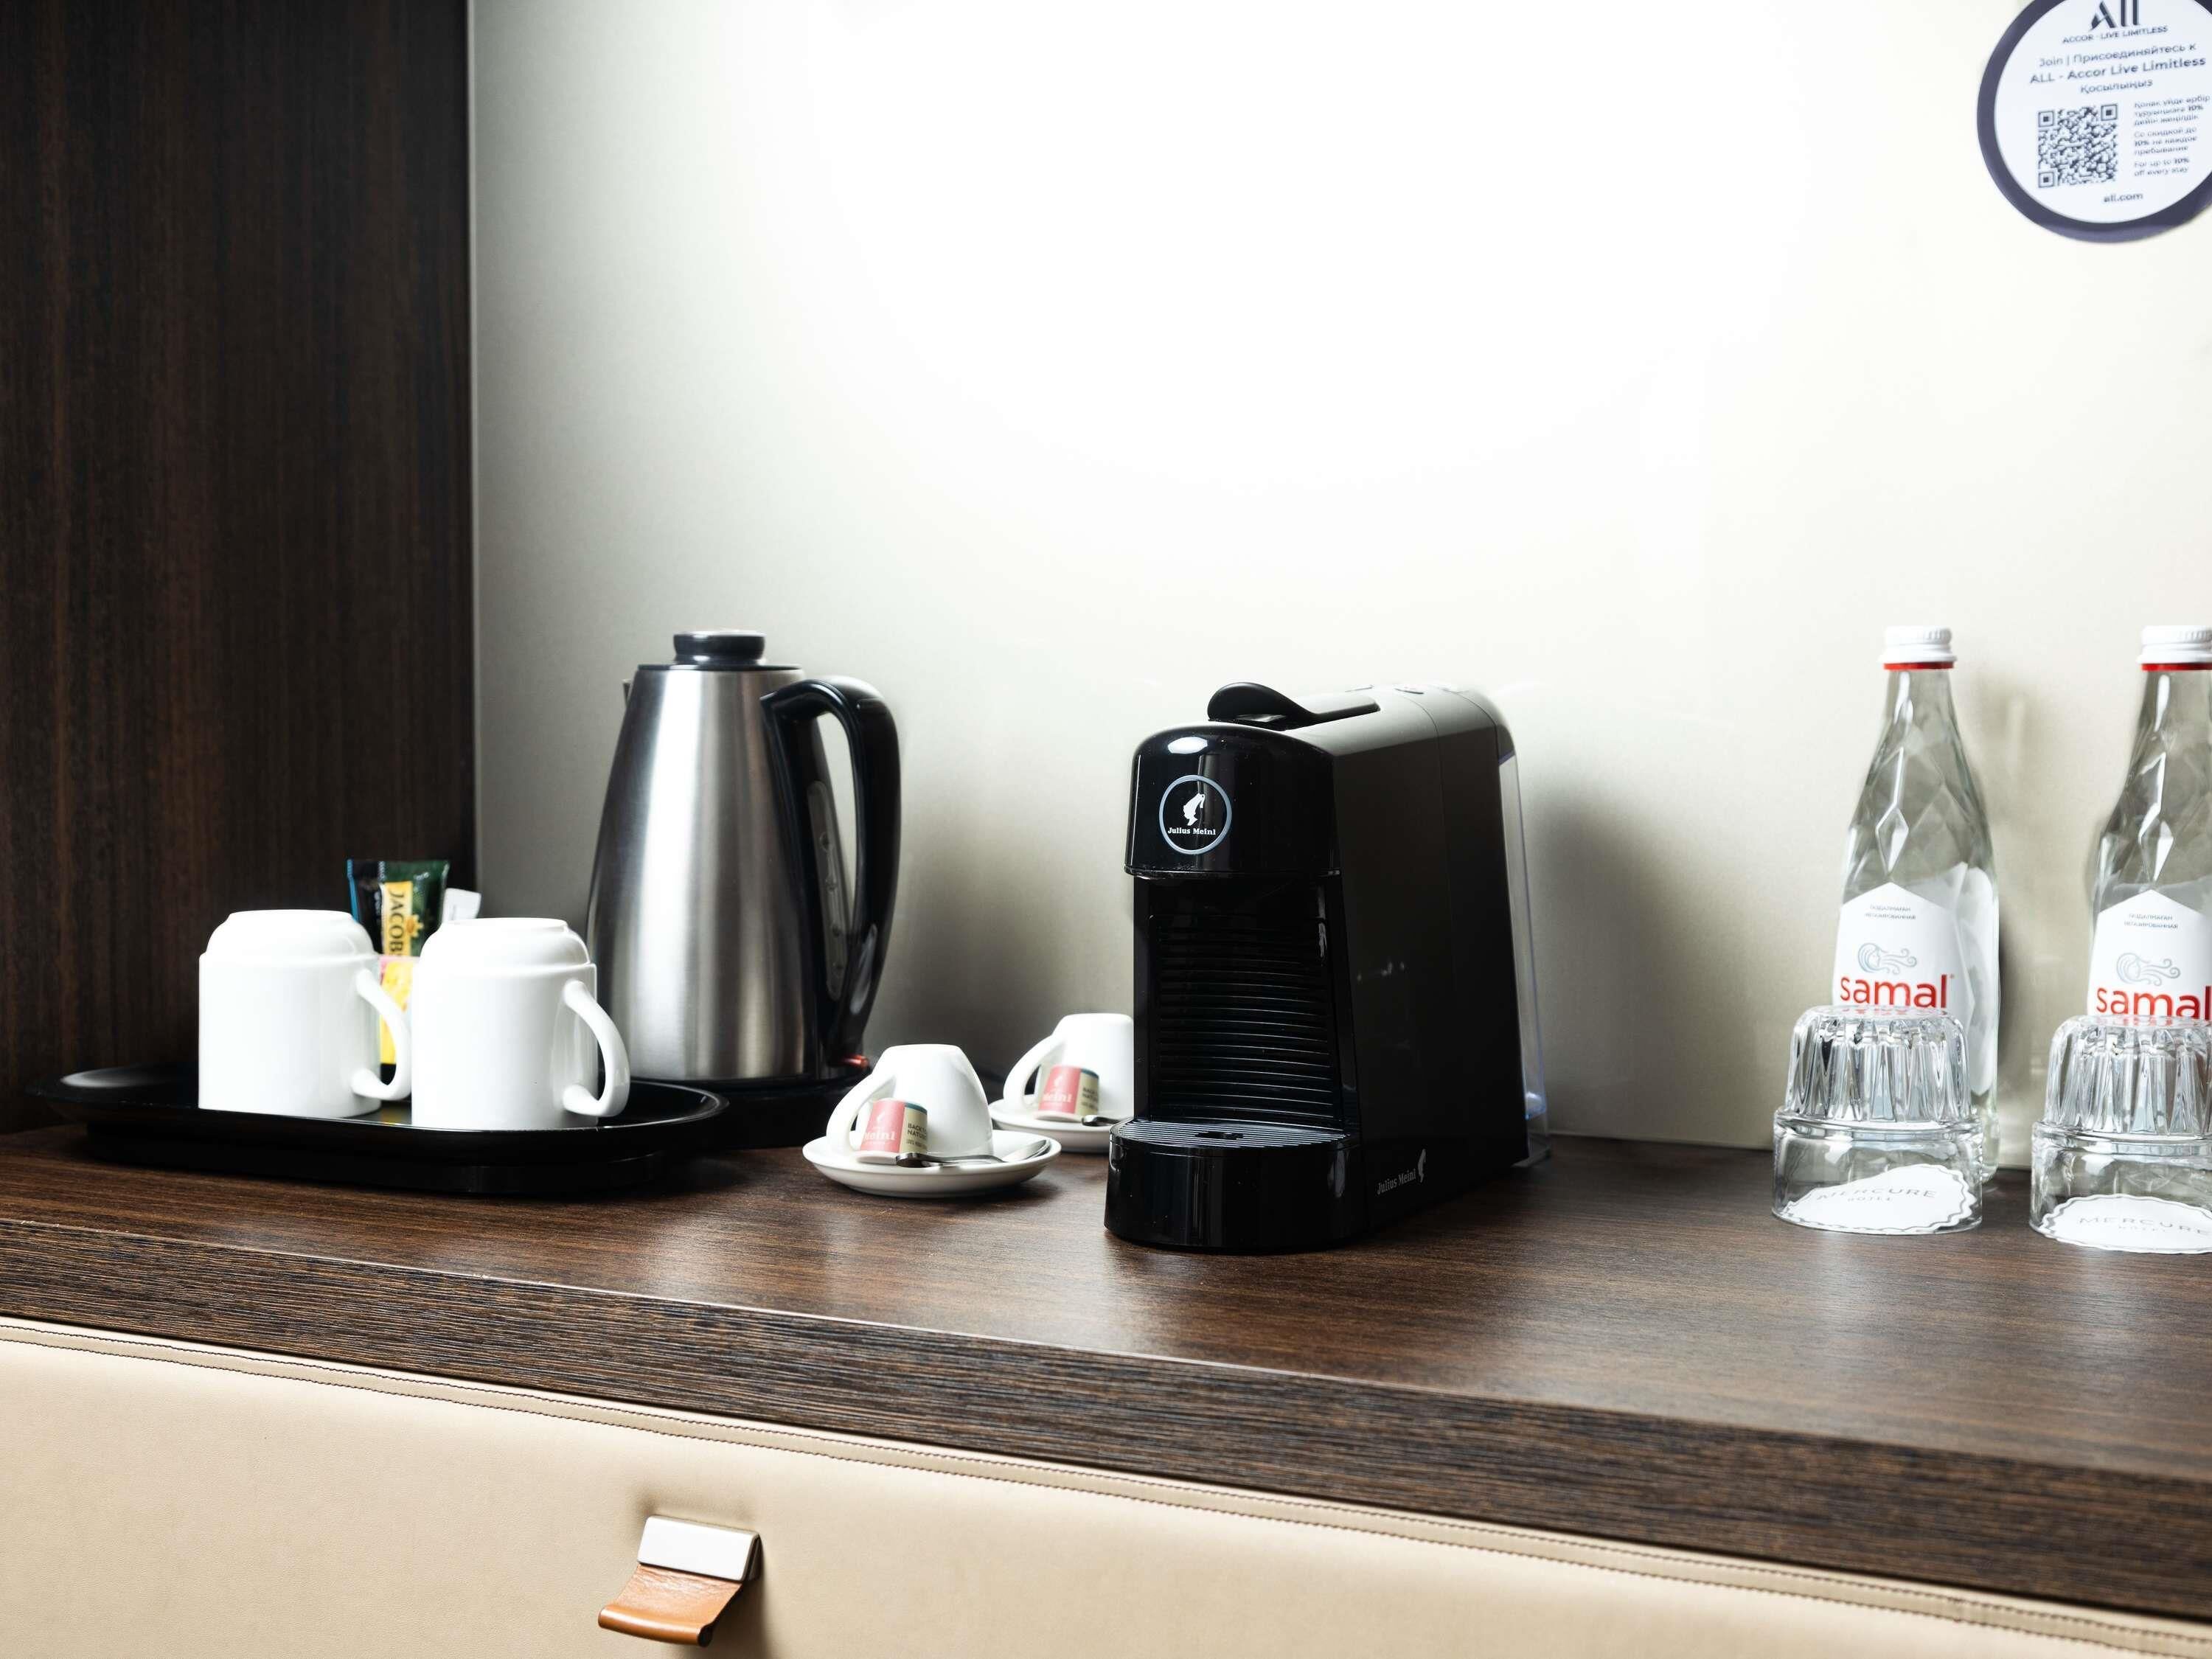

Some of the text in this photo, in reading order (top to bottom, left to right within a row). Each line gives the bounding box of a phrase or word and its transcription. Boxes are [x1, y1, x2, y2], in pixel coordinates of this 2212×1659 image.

[2062, 25, 2168, 44] ACCOR LIVE LIMITLESS
[2039, 56, 2064, 67] Join
[2073, 45, 2186, 64] Присоединяйтесь
[2029, 73, 2056, 84] ALL
[2067, 68, 2107, 80] Accor
[2110, 63, 2139, 75] Live
[2143, 57, 2207, 72] Limitless
[2104, 193, 2143, 203] all.com
[1840, 974, 1947, 1009] samal
[2096, 985, 2212, 1021] samal
[1377, 1168, 1416, 1195] Julius Meinl
[1817, 1187, 1938, 1200] MERCURE
[2079, 1217, 2212, 1236] MERCURE
